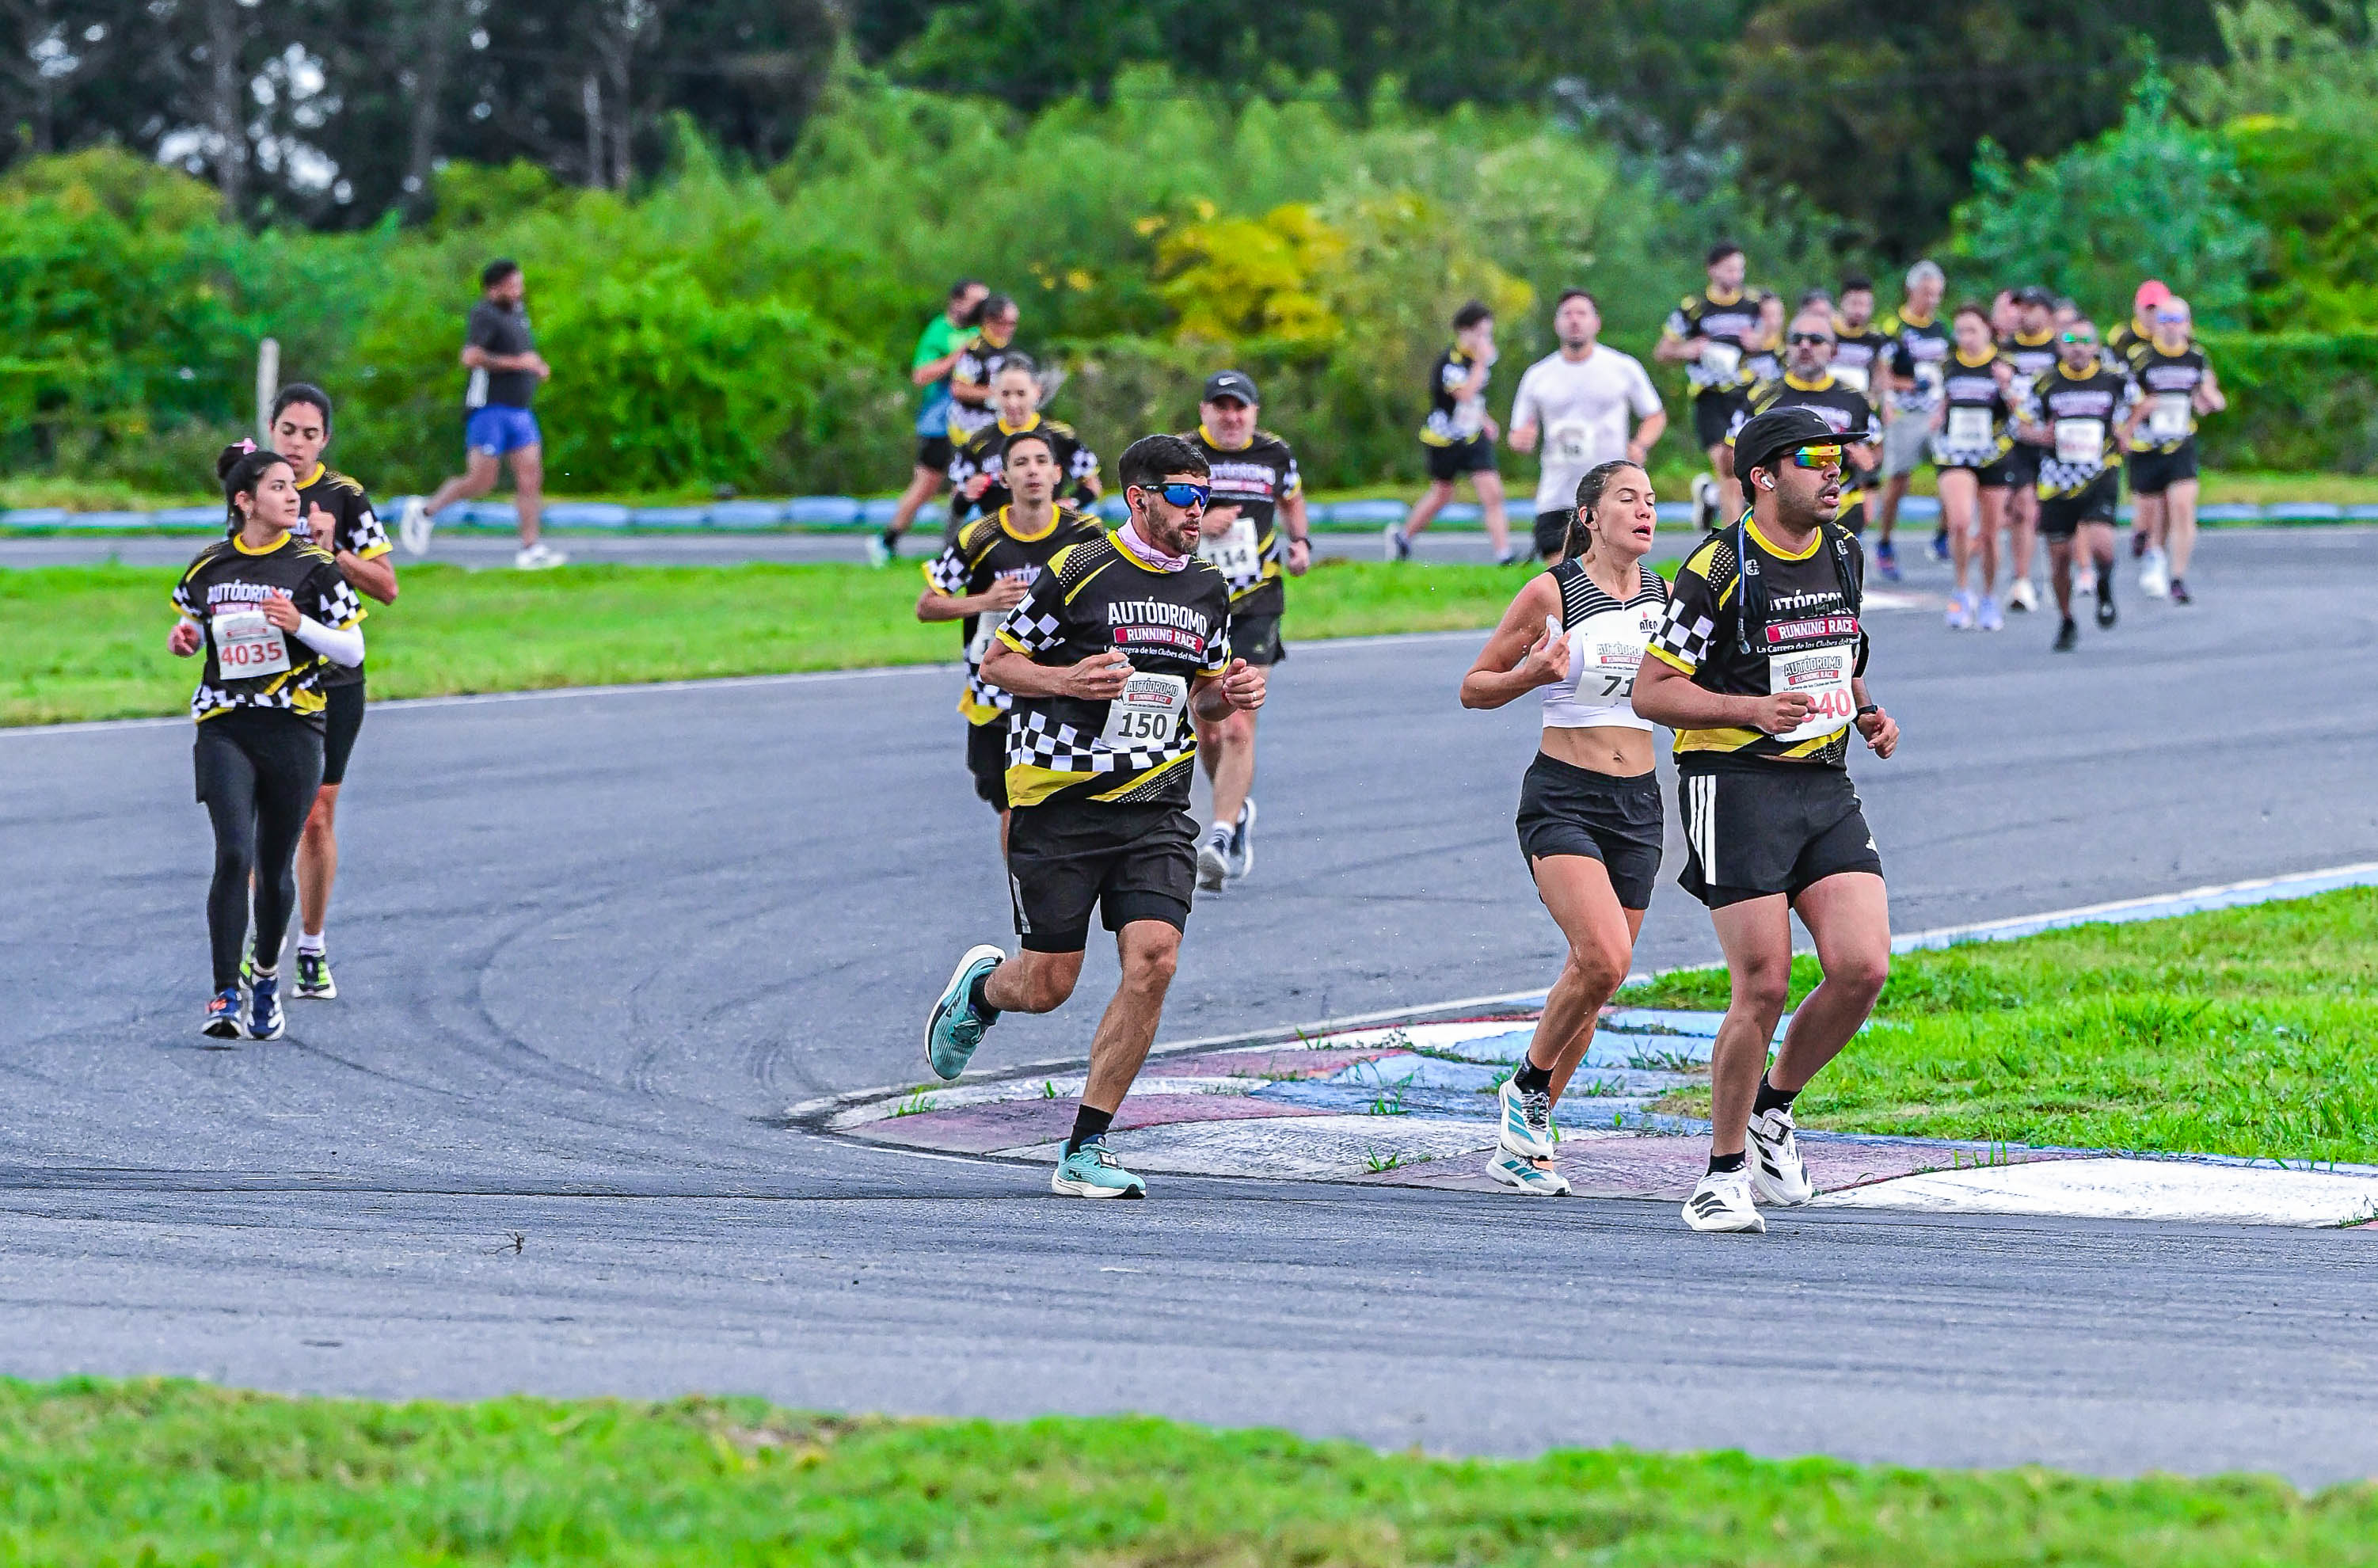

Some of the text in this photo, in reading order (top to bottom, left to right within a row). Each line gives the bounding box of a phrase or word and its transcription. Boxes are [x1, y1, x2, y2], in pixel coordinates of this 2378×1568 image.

[1108, 596, 1208, 637] AUTÓDROMO
[1126, 627, 1197, 649] RUNNING RACE
[1777, 619, 1854, 640] RUNNING RACE
[222, 641, 283, 666] 4035
[1158, 648, 1178, 657] Clubes
[1178, 651, 1188, 660] del
[1783, 656, 1843, 676] AUTÓDROMO
[1127, 678, 1178, 697] AUTÓDROMO
[1118, 713, 1167, 740] 150
